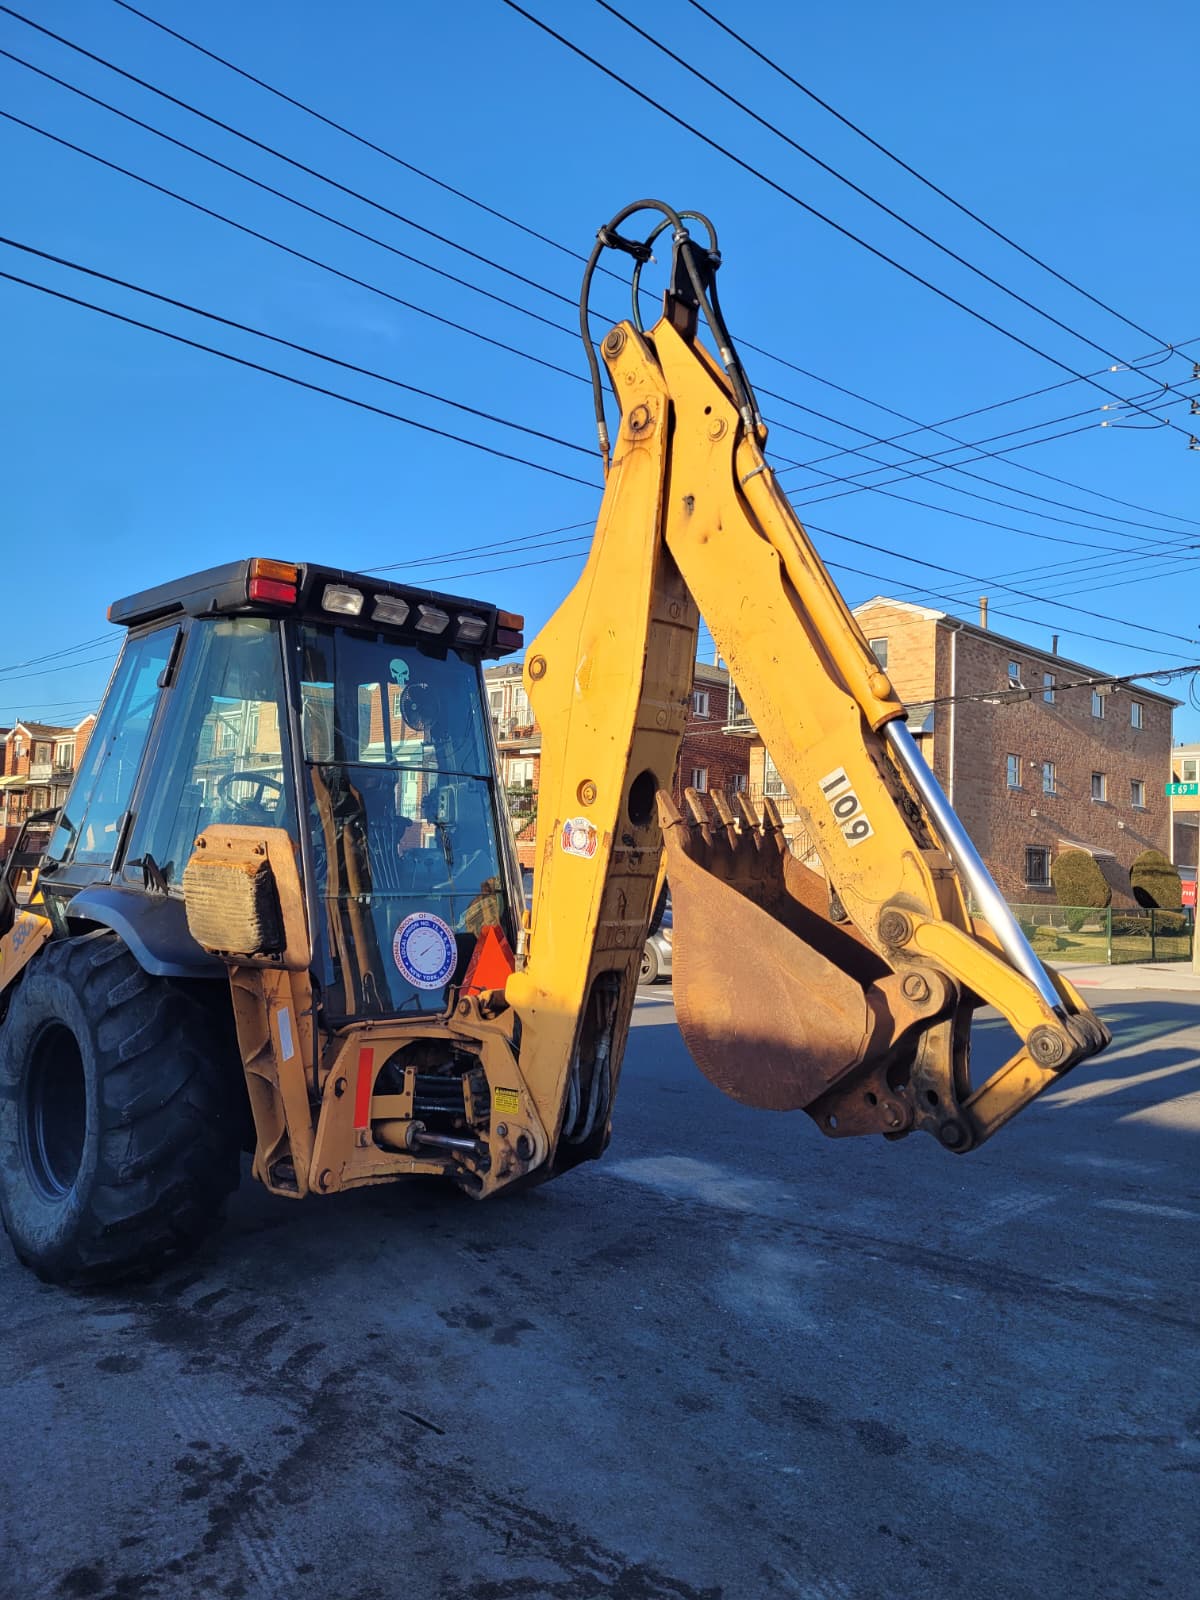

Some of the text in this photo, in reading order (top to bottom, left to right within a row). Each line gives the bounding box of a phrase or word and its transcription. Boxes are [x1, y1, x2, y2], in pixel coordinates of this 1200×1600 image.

[1171, 784, 1176, 794] E
[1178, 784, 1188, 794] 69
[822, 774, 870, 840] 109
[398, 917, 414, 935] UNION
[405, 921, 420, 938] UNION
[431, 916, 455, 945] OPERATING
[393, 941, 422, 987] INTERNATIONAL
[409, 967, 422, 979] NEW
